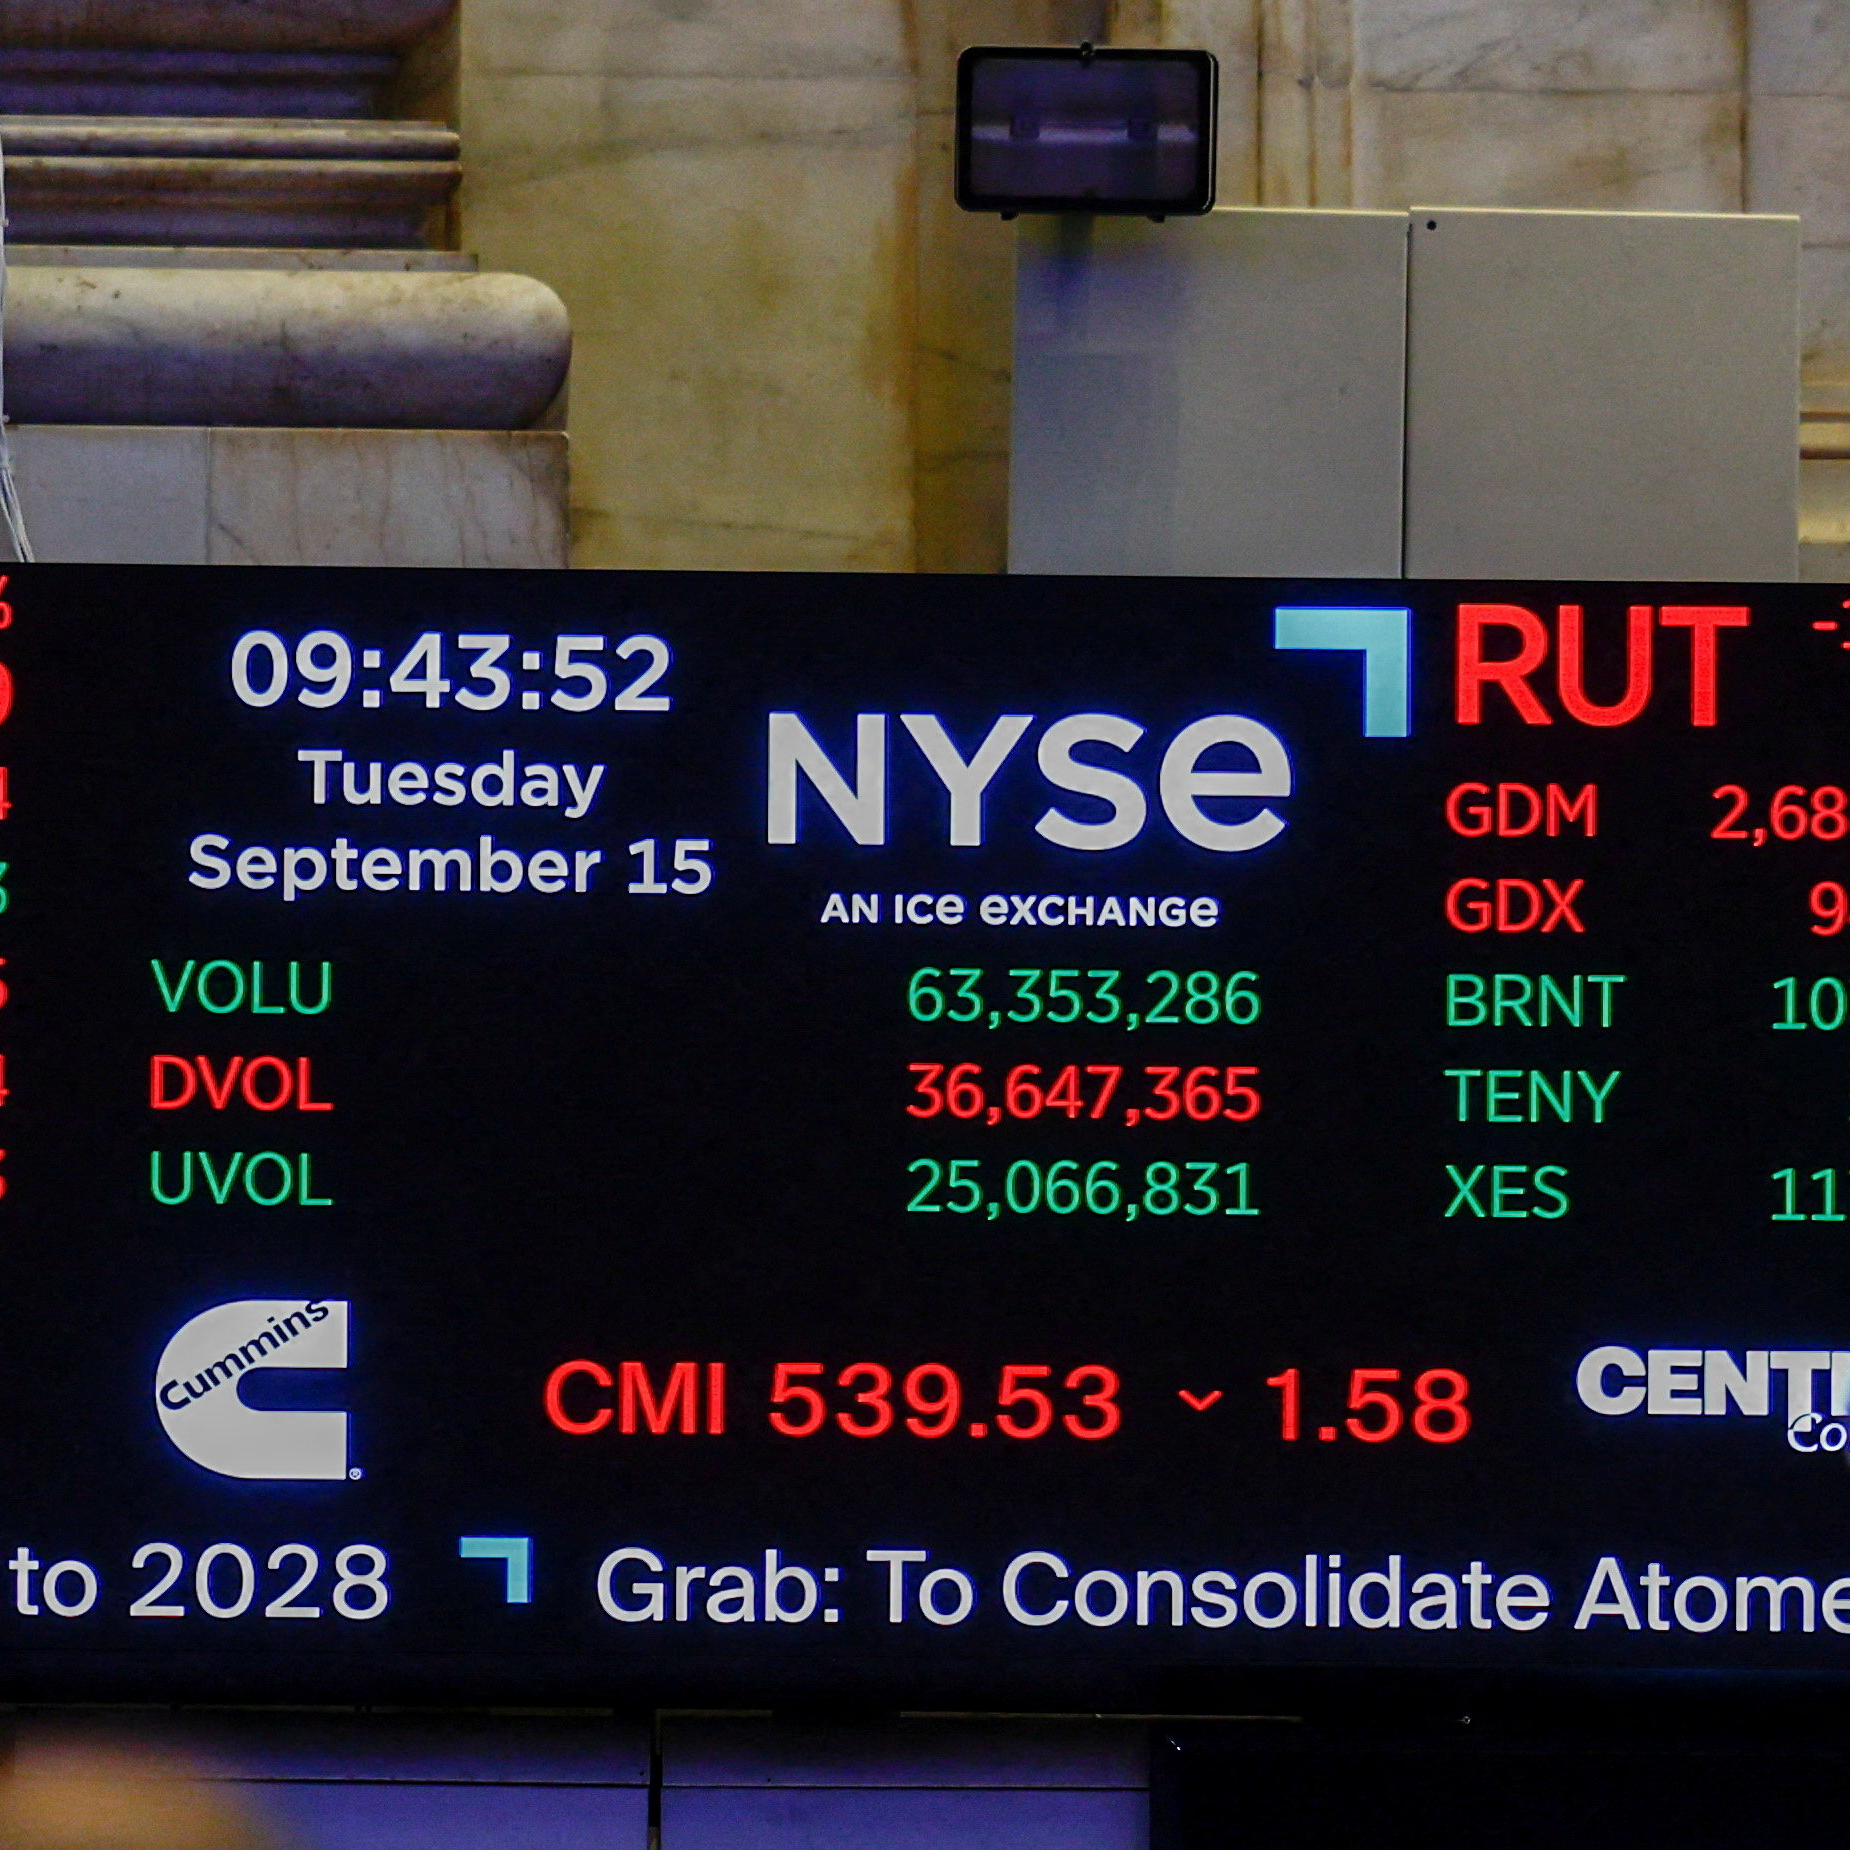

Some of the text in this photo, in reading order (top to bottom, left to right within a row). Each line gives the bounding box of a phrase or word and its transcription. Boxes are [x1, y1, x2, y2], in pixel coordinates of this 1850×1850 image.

[232, 628, 674, 712] 09:43:52
[1456, 603, 1750, 726] RUT
[298, 748, 608, 818] Tuesday
[1446, 782, 1597, 837] GDM
[189, 832, 716, 901] September 15
[820, 892, 883, 923] AN
[1445, 877, 1585, 933] GDX
[151, 960, 1259, 1030] VOLU 63,353,286
[1447, 974, 1625, 1027] BRNT
[151, 1055, 1261, 1126] DVOL 36,647,365
[1444, 1070, 1620, 1123] TENY
[152, 1151, 1259, 1221] UVOL 25,066,831
[1445, 1165, 1567, 1218] XES
[159, 1301, 330, 1411] Cummins
[544, 1359, 1471, 1444] CMI 539.53 1.58
[9, 1547, 102, 1617] to
[130, 1541, 392, 1619] 2028
[597, 1547, 843, 1623] Grab:
[867, 1549, 977, 1625] To
[1003, 1551, 1553, 1630] Consolidate
